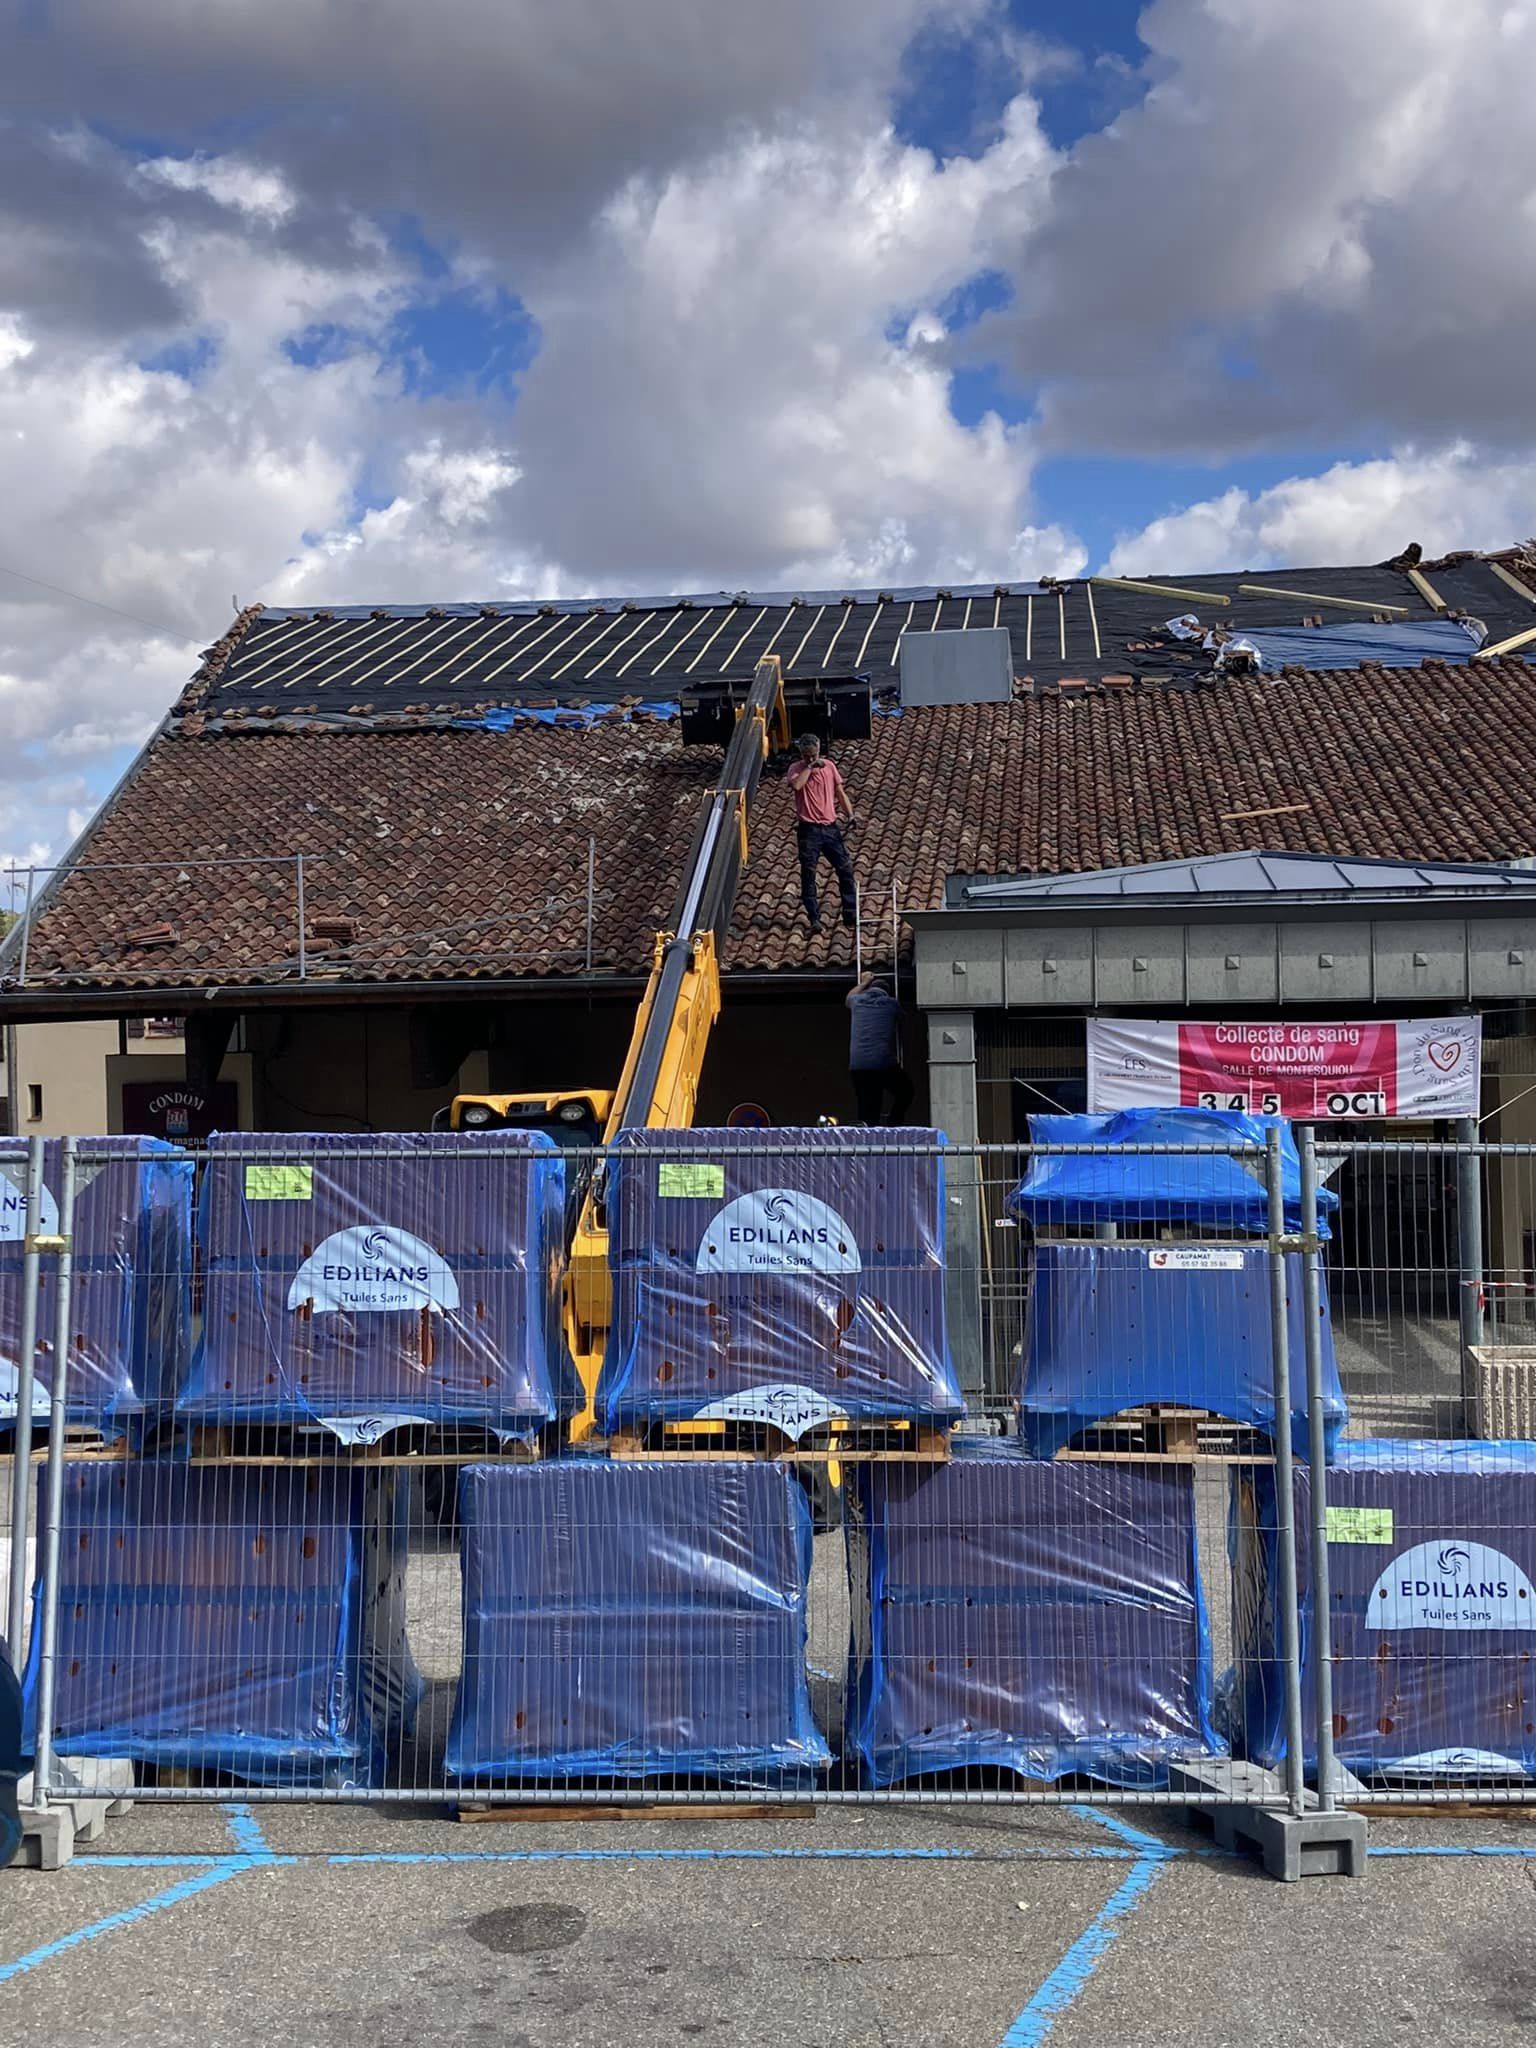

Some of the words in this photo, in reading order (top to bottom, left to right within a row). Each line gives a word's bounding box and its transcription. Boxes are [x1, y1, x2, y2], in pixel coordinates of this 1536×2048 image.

[1215, 1026, 1285, 1044] Collecte
[1290, 1026, 1312, 1043] de
[1316, 1029, 1359, 1046] sang
[1250, 1045, 1325, 1063] CONDOM
[1412, 1049, 1425, 1076] Don
[1430, 1023, 1461, 1036] Sang
[1124, 1058, 1146, 1071] EFS
[1223, 1065, 1254, 1076] SALLE
[1258, 1065, 1273, 1076] DE
[1277, 1064, 1353, 1076] MONTESQUIOU
[148, 1091, 205, 1113] CONDOM
[1201, 1093, 1217, 1110] 3
[1228, 1094, 1246, 1111] 4
[1262, 1094, 1279, 1115] 5
[1327, 1093, 1385, 1115] OCT
[729, 1227, 828, 1244] EDILIANS
[747, 1253, 783, 1265] Tuiles
[786, 1255, 813, 1266] Sans
[323, 1265, 428, 1282] EDILIANS
[342, 1292, 377, 1303] Tuiles
[380, 1292, 408, 1303] Sans
[728, 1407, 821, 1426] EDILIANS
[1401, 1581, 1509, 1598] EDILIANS
[1421, 1608, 1458, 1621] Tuiles
[1462, 1609, 1492, 1621] Sans
